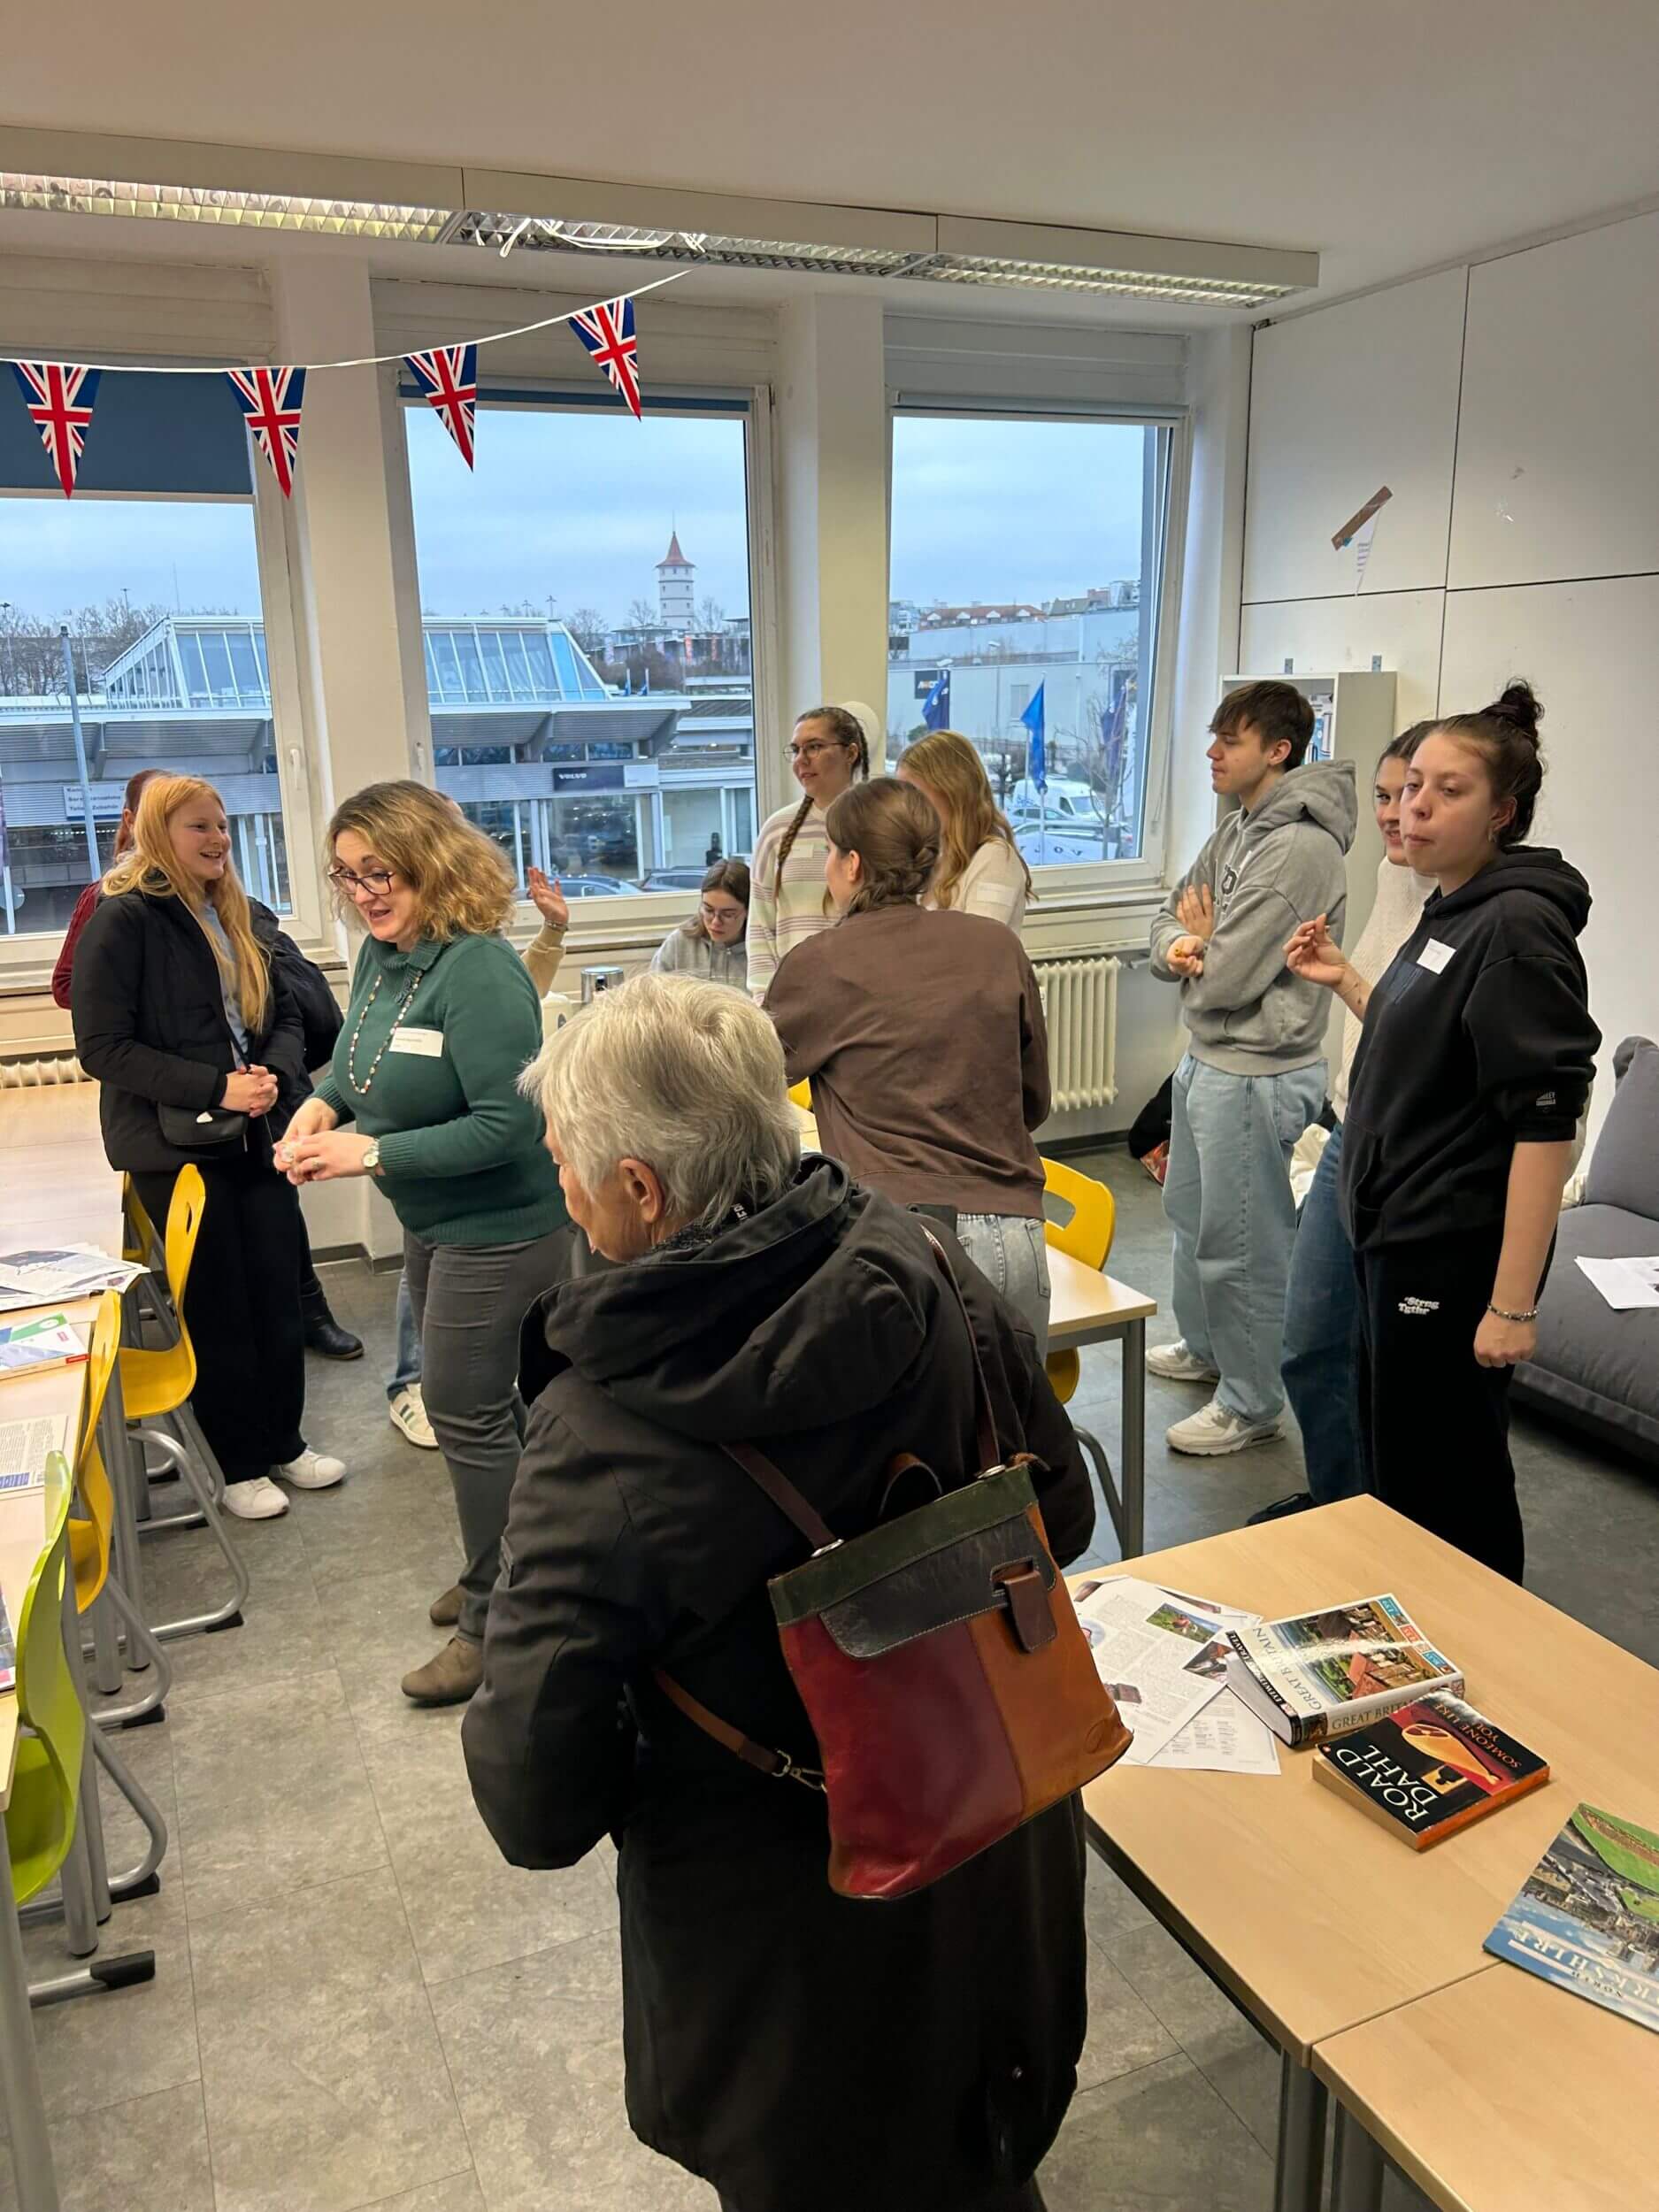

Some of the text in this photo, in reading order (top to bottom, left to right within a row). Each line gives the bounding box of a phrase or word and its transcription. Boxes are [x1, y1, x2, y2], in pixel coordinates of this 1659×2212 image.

[1230, 1633, 1250, 1661] TRAVEL
[1287, 1675, 1322, 1710] GREAT
[1332, 1711, 1370, 1731] GREAT
[1434, 1703, 1522, 1768] SOMEONE LIKE
[1473, 1722, 1500, 1742] YOU
[1336, 1748, 1429, 1821] ROALD
[1363, 1745, 1439, 1805] DAHL
[1513, 1926, 1659, 2005] RKSHIRE
